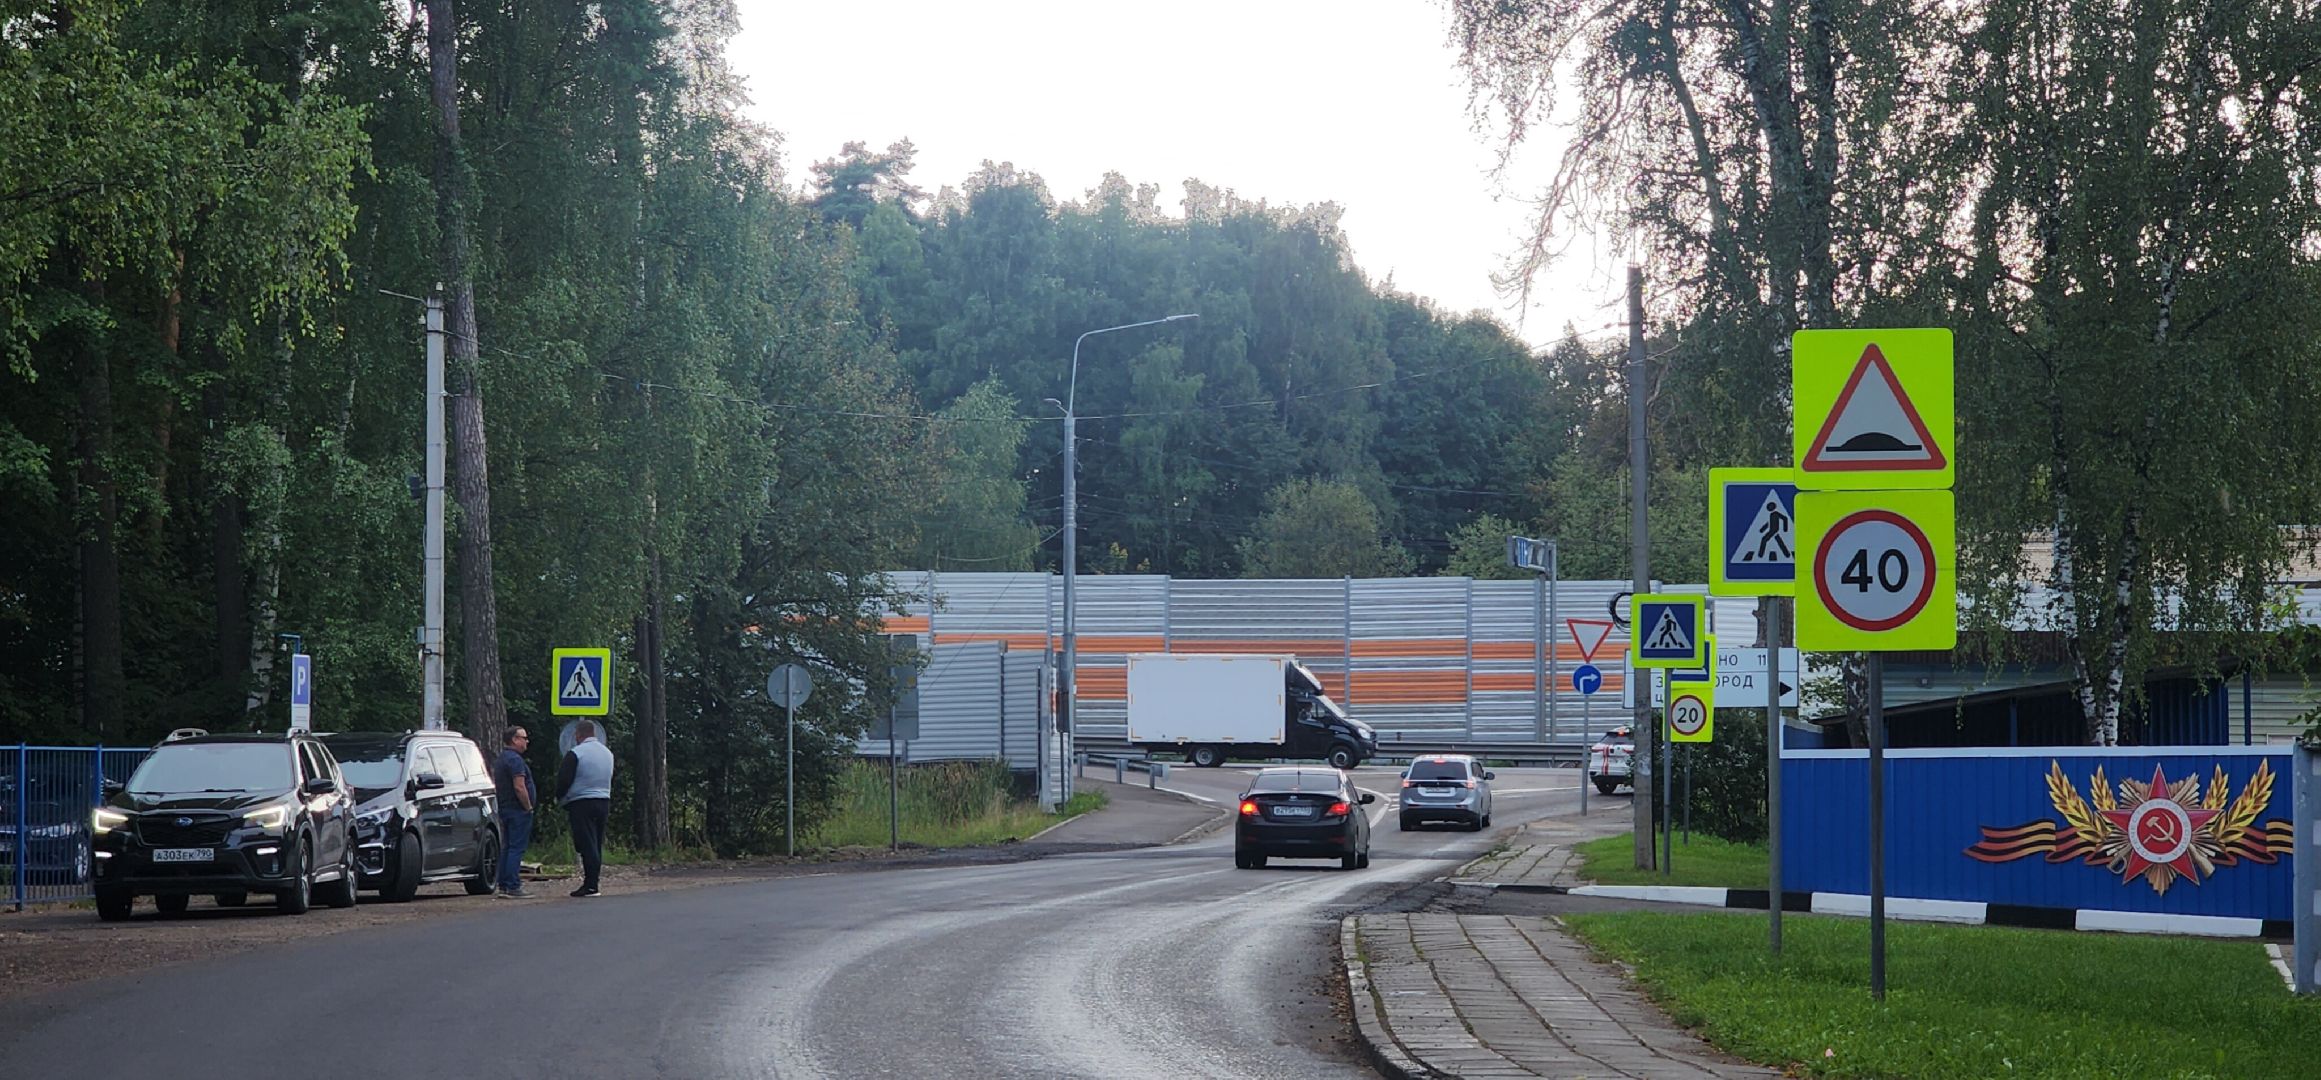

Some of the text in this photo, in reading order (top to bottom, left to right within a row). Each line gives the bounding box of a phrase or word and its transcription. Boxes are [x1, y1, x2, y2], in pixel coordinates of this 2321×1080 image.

[1841, 549, 1909, 593] 40
[297, 666, 306, 696] P
[1677, 707, 1699, 723] 20
